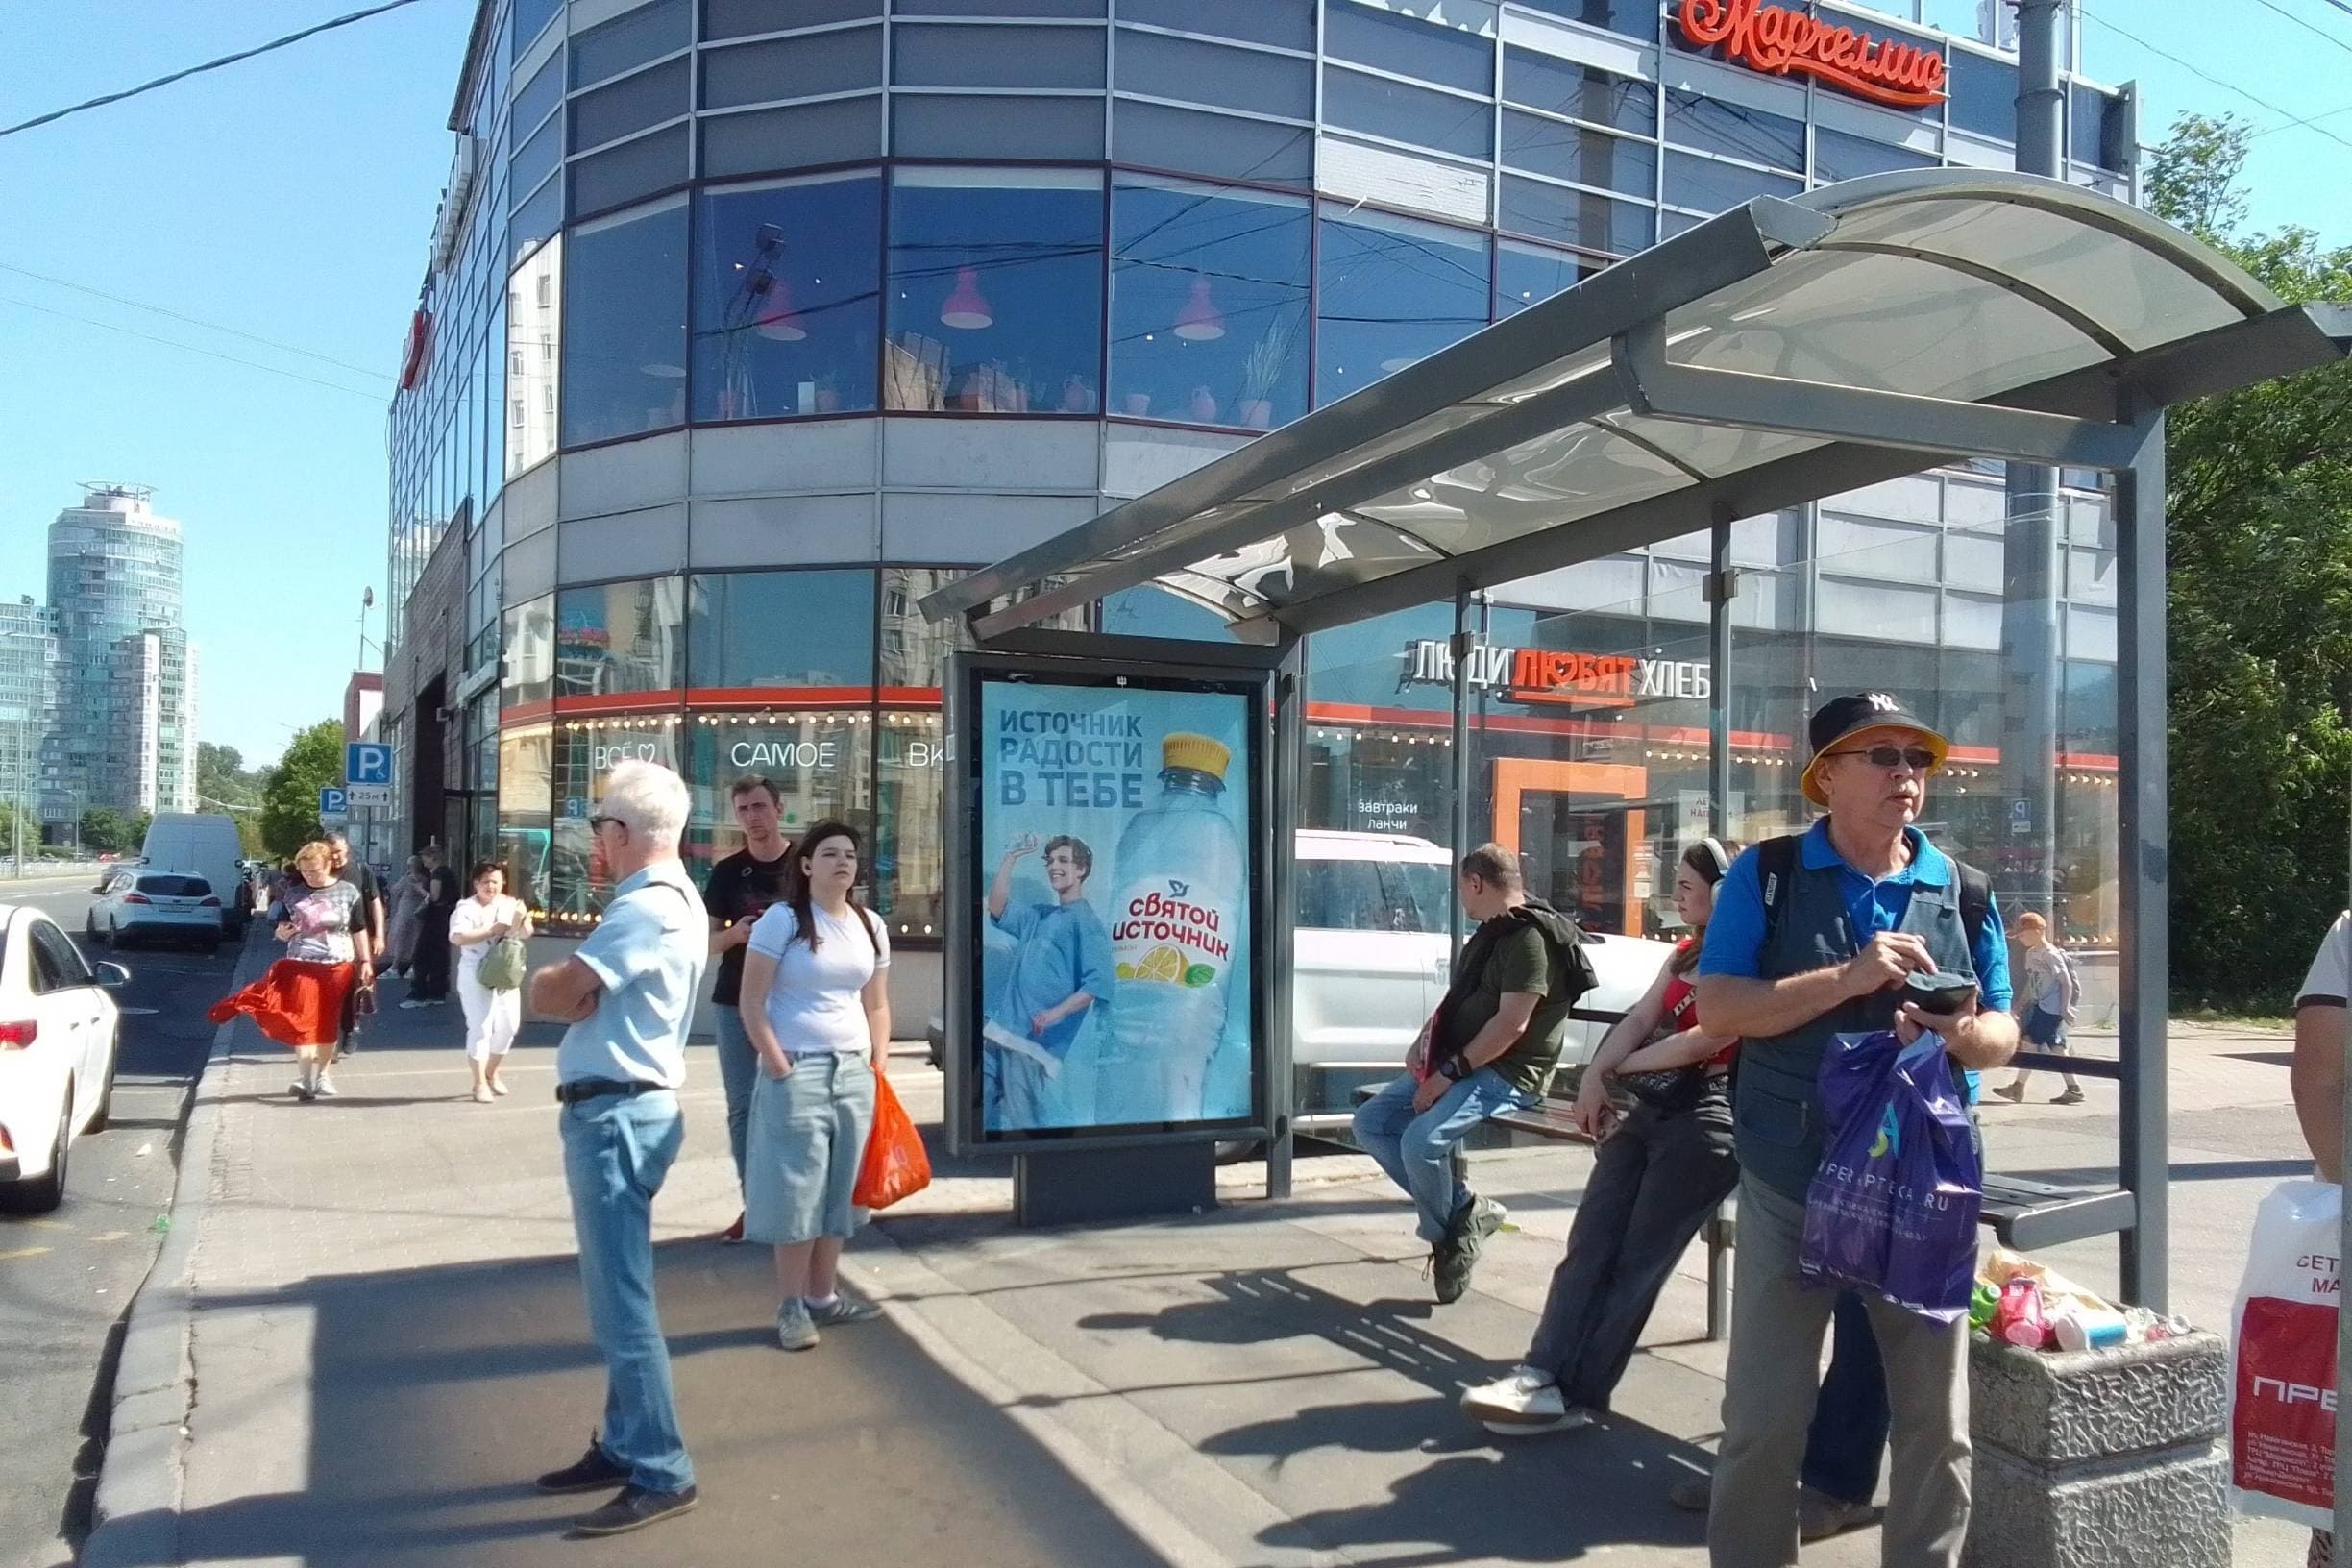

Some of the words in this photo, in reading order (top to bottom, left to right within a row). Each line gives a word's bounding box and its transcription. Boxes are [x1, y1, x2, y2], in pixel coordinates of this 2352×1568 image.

[1511, 649, 1637, 694] ЛЮБЯТ
[1639, 659, 1711, 699] ХЛЕБ
[1000, 709, 1143, 738] ИСТОЧНИК
[358, 747, 384, 779] P
[730, 742, 836, 768] САМОЕ
[1000, 737, 1143, 769] РАДОСТИ
[328, 790, 344, 811] P
[1001, 770, 1027, 805] В
[1037, 771, 1144, 808] ТЕБЕ
[1367, 818, 1408, 830] ланчи
